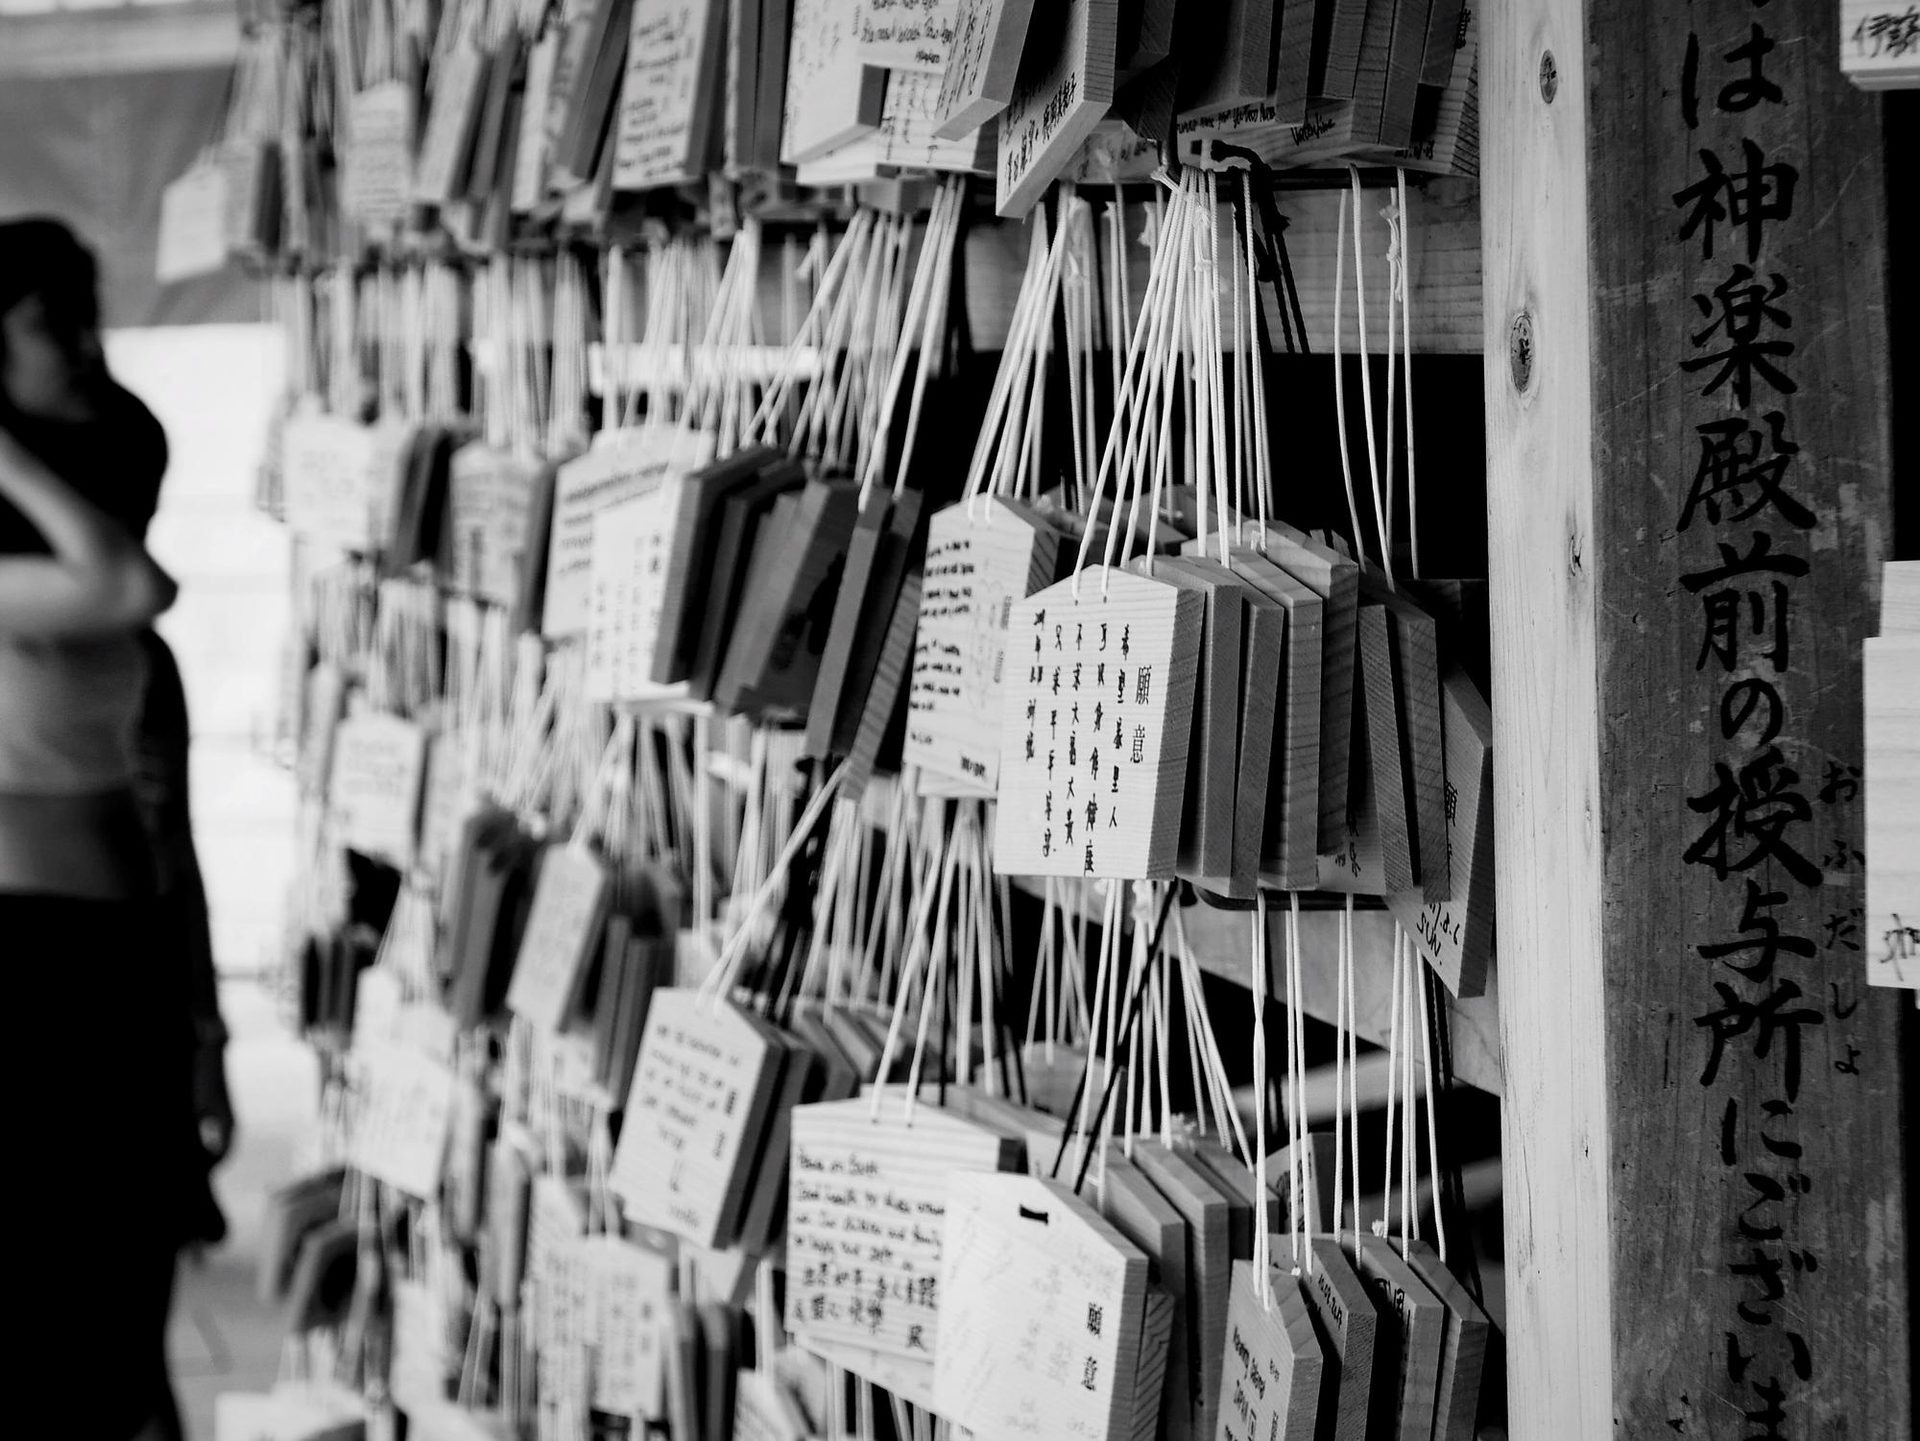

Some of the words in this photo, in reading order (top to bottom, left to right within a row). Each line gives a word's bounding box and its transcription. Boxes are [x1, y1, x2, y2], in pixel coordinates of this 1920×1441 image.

[1672, 0, 1825, 1441] は神楽殿前の授与所にございま
